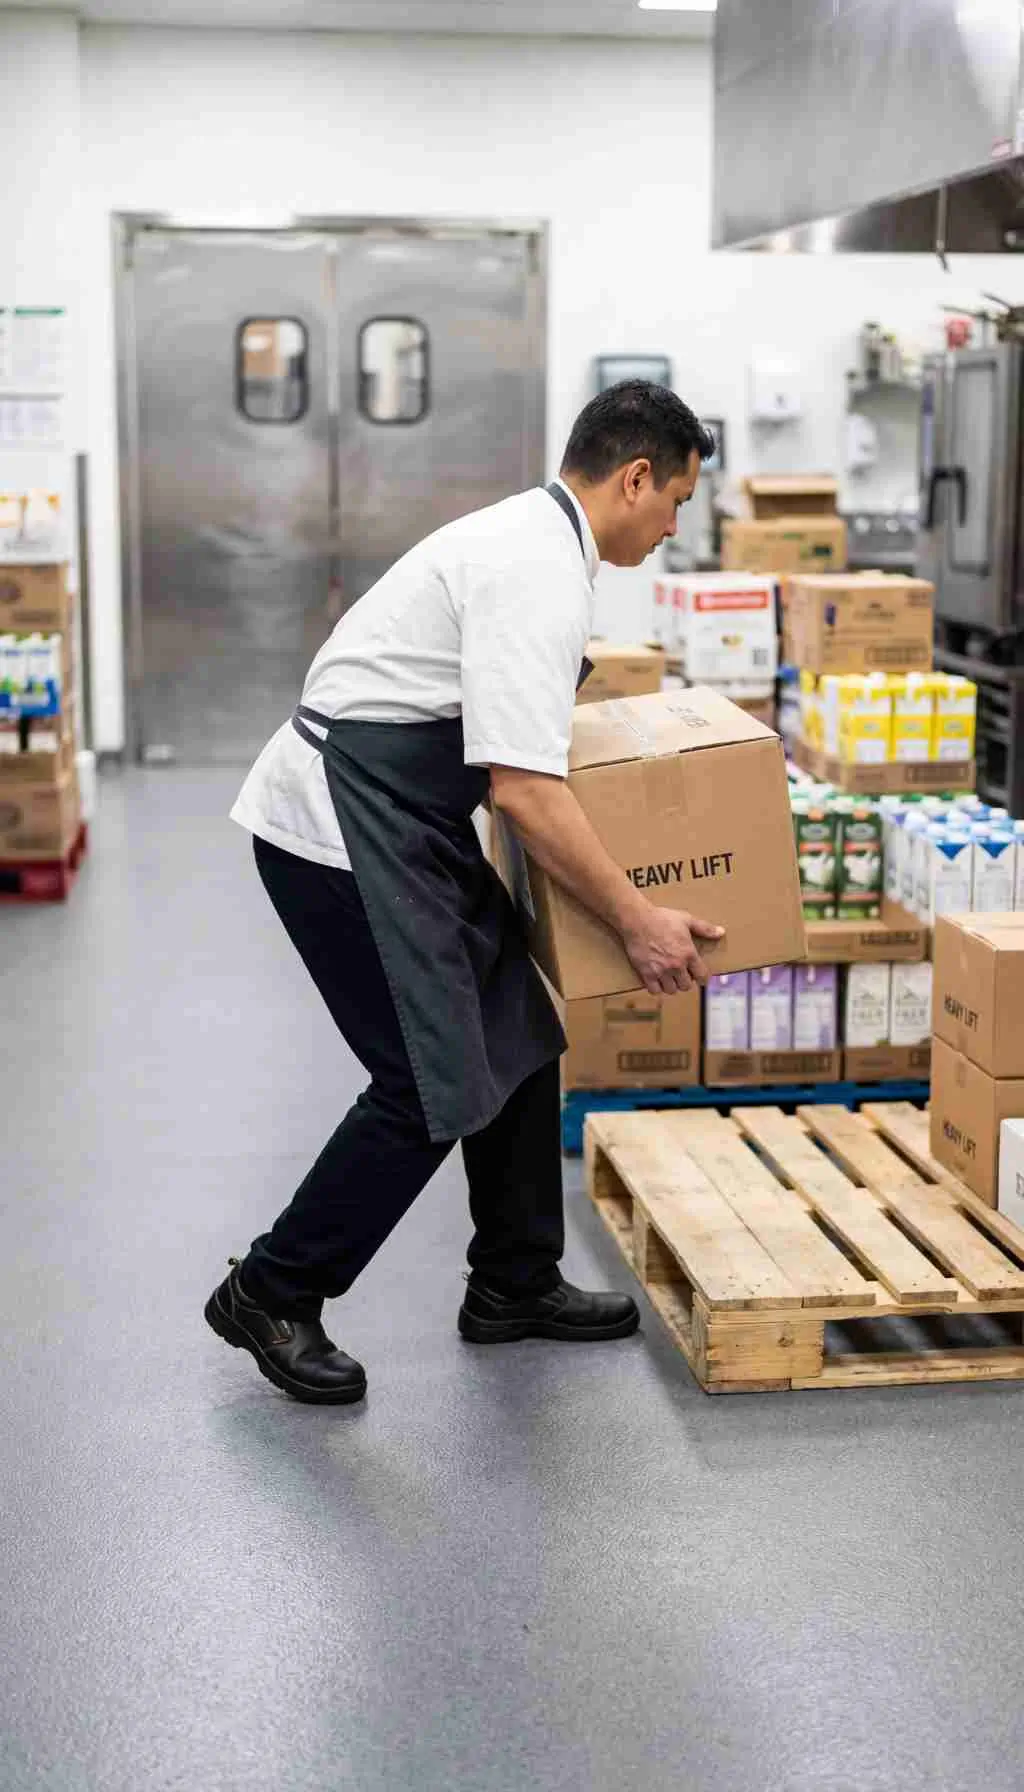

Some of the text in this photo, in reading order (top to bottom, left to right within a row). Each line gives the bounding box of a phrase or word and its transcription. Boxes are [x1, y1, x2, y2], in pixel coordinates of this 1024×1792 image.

[690, 853, 733, 879] LIFT
[944, 993, 964, 1022] HEAVY
[964, 1007, 979, 1033] LIFT
[943, 1119, 977, 1161] HEAVY LIFT
